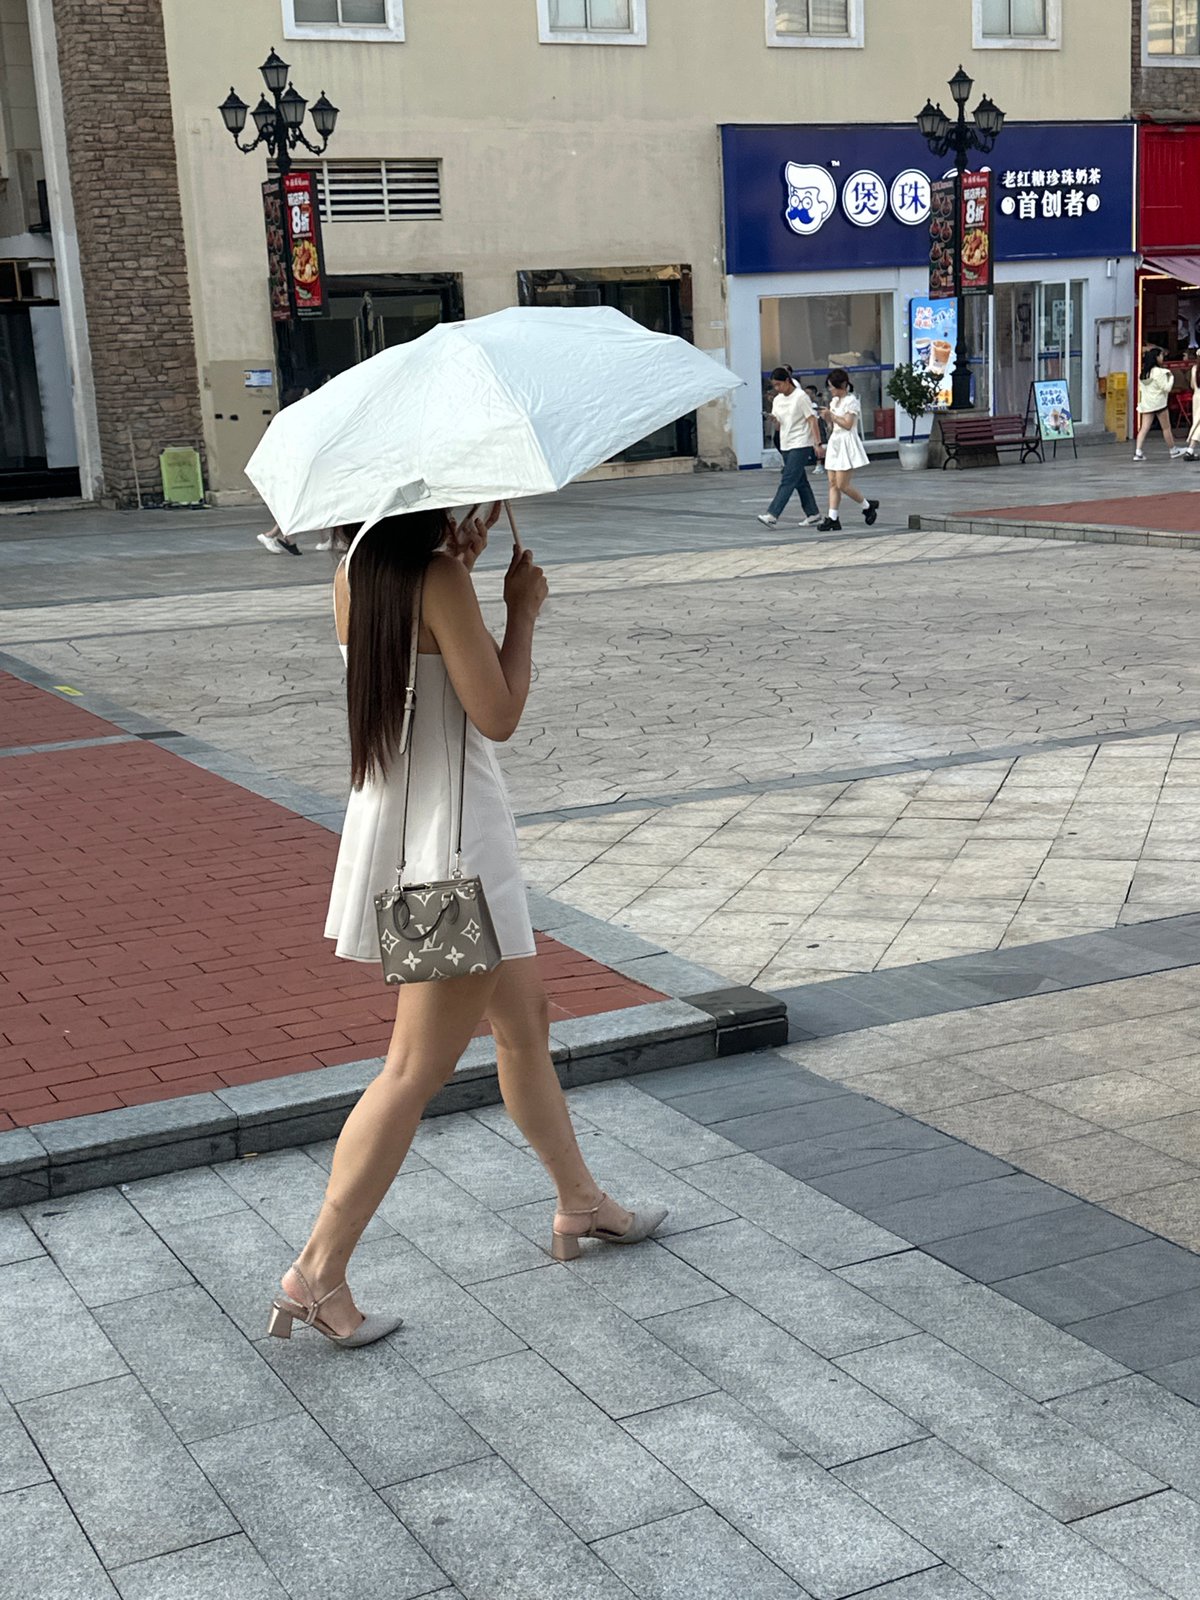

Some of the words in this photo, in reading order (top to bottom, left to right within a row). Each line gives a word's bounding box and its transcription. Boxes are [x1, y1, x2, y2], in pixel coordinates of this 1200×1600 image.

[1002, 168, 1101, 188] 老红糖珍珠奶茶
[965, 199, 985, 224] 8折
[1017, 188, 1085, 219] 首创者
